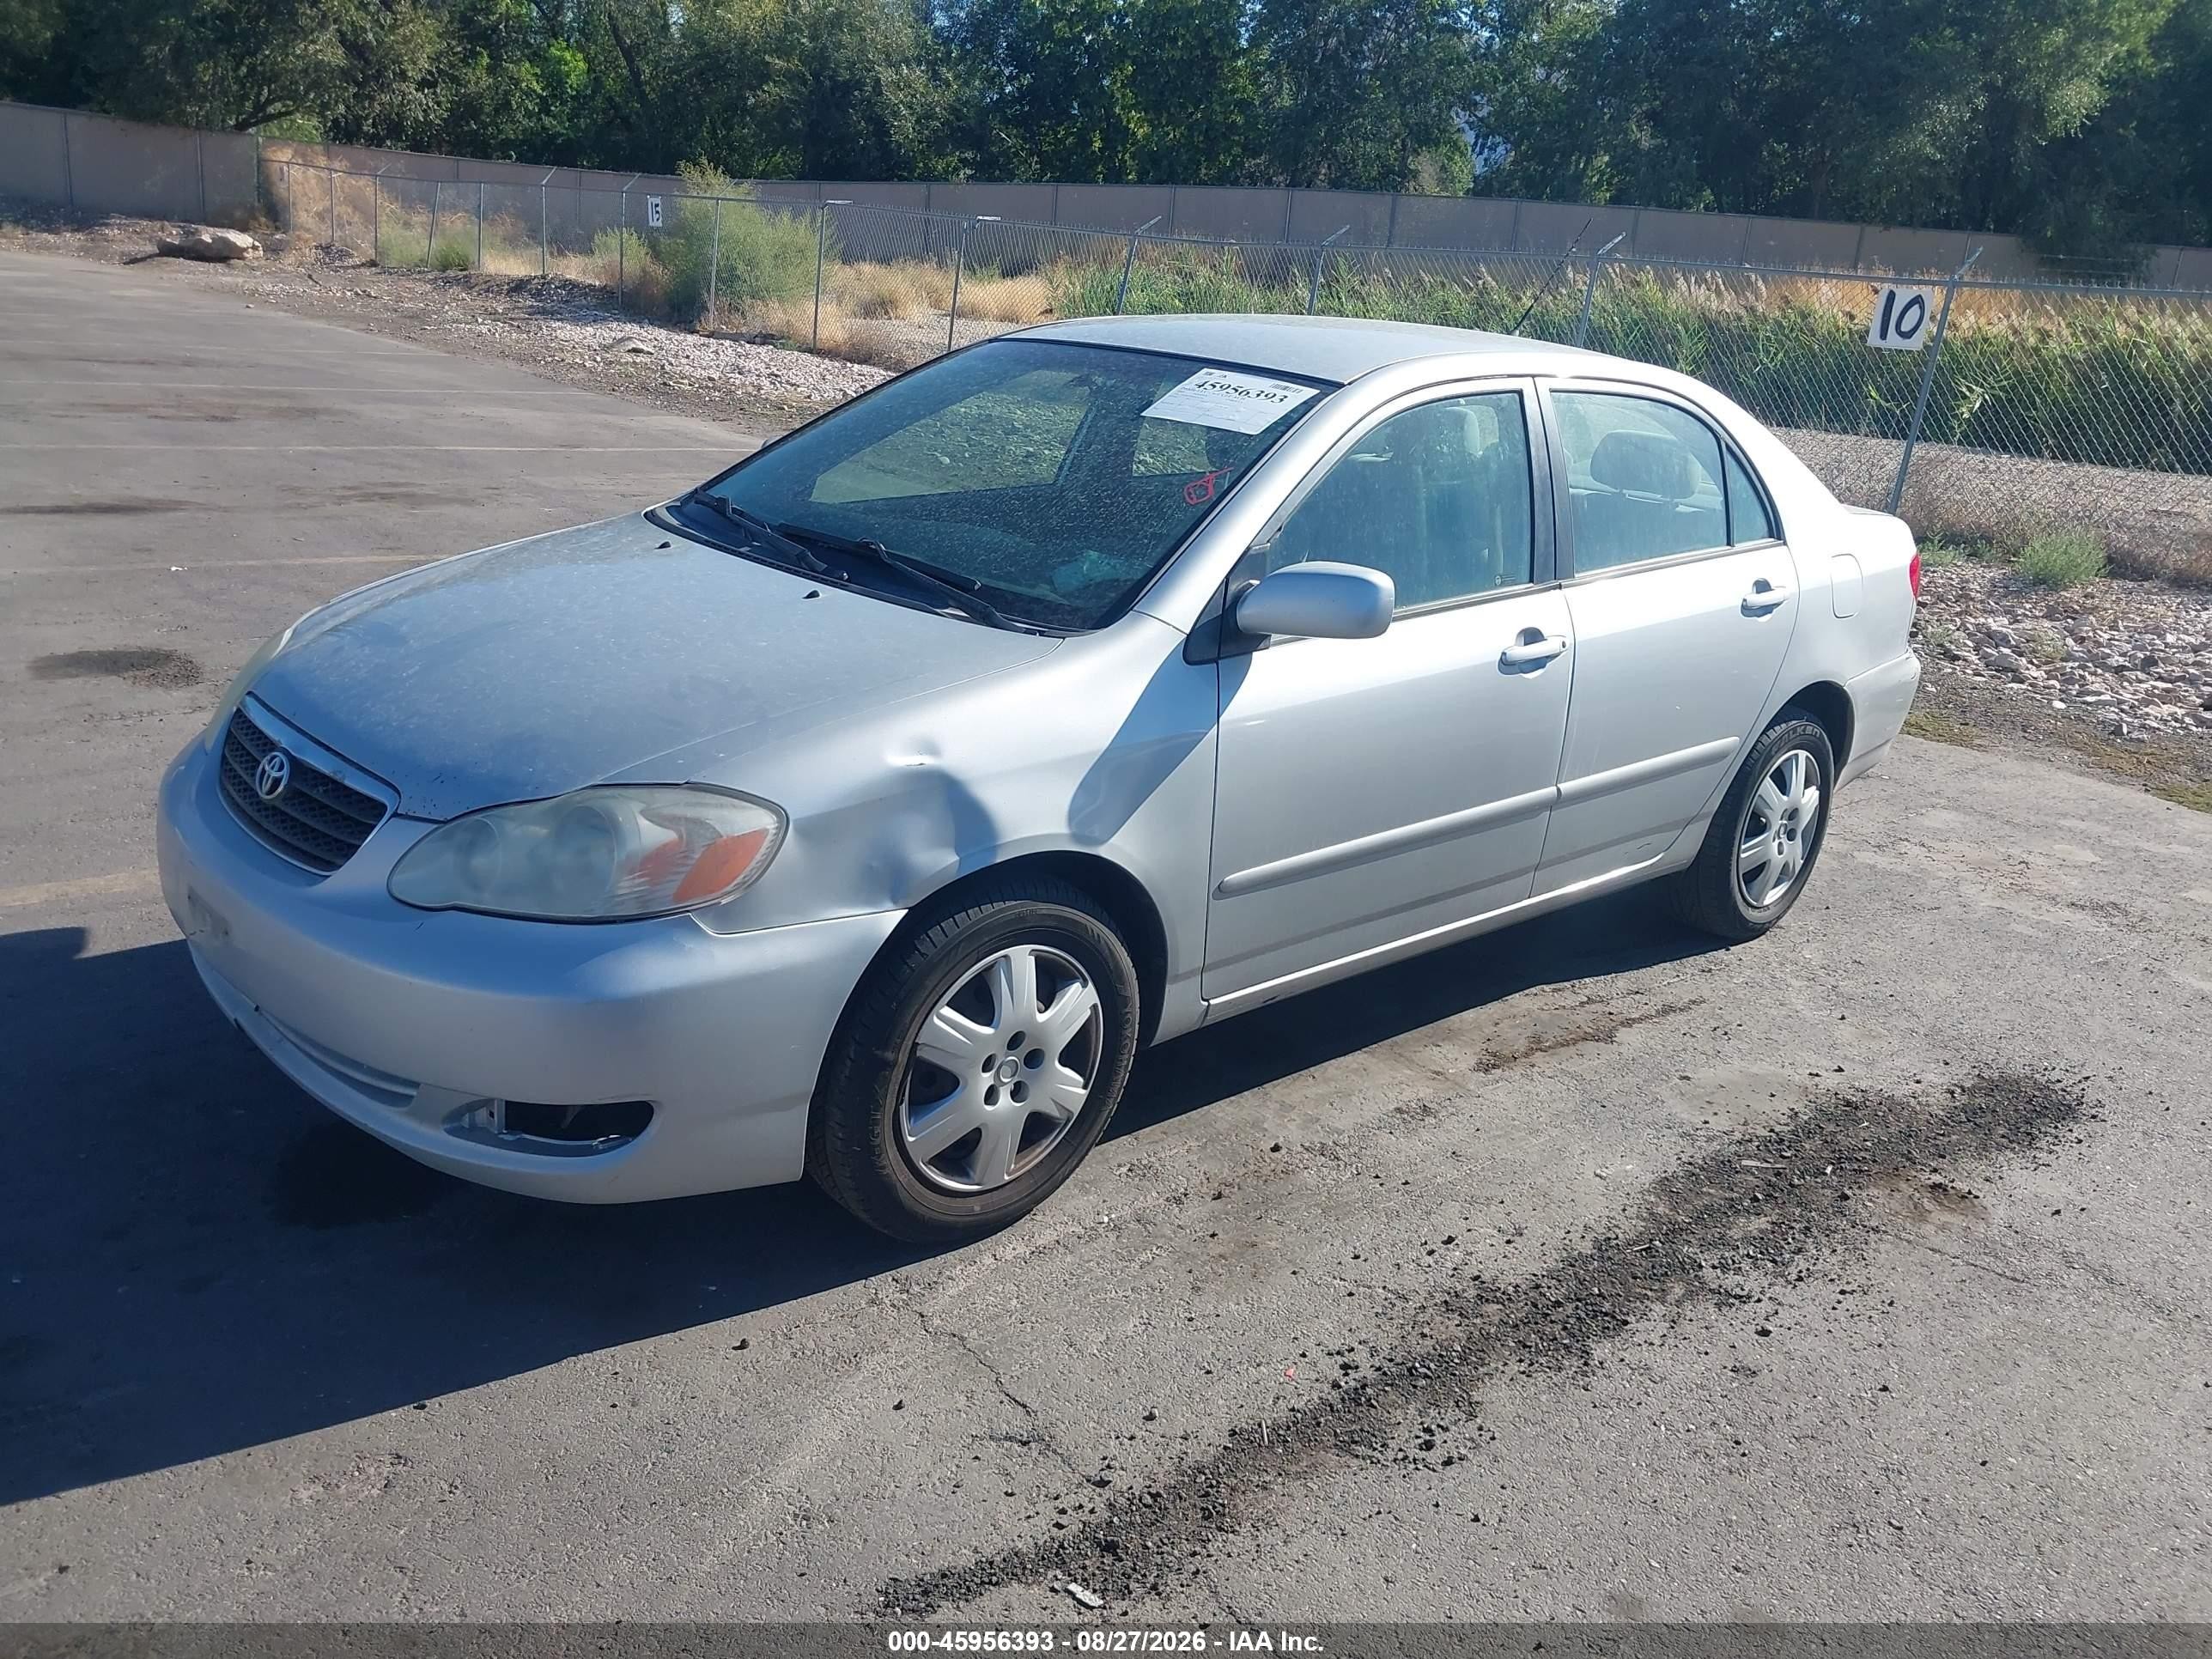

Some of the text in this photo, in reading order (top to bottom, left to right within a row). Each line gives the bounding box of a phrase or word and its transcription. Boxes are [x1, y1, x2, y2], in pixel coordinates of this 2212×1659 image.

[651, 201, 660, 222] 15
[1880, 289, 1925, 341] 10
[1195, 380, 1289, 404] 45956393
